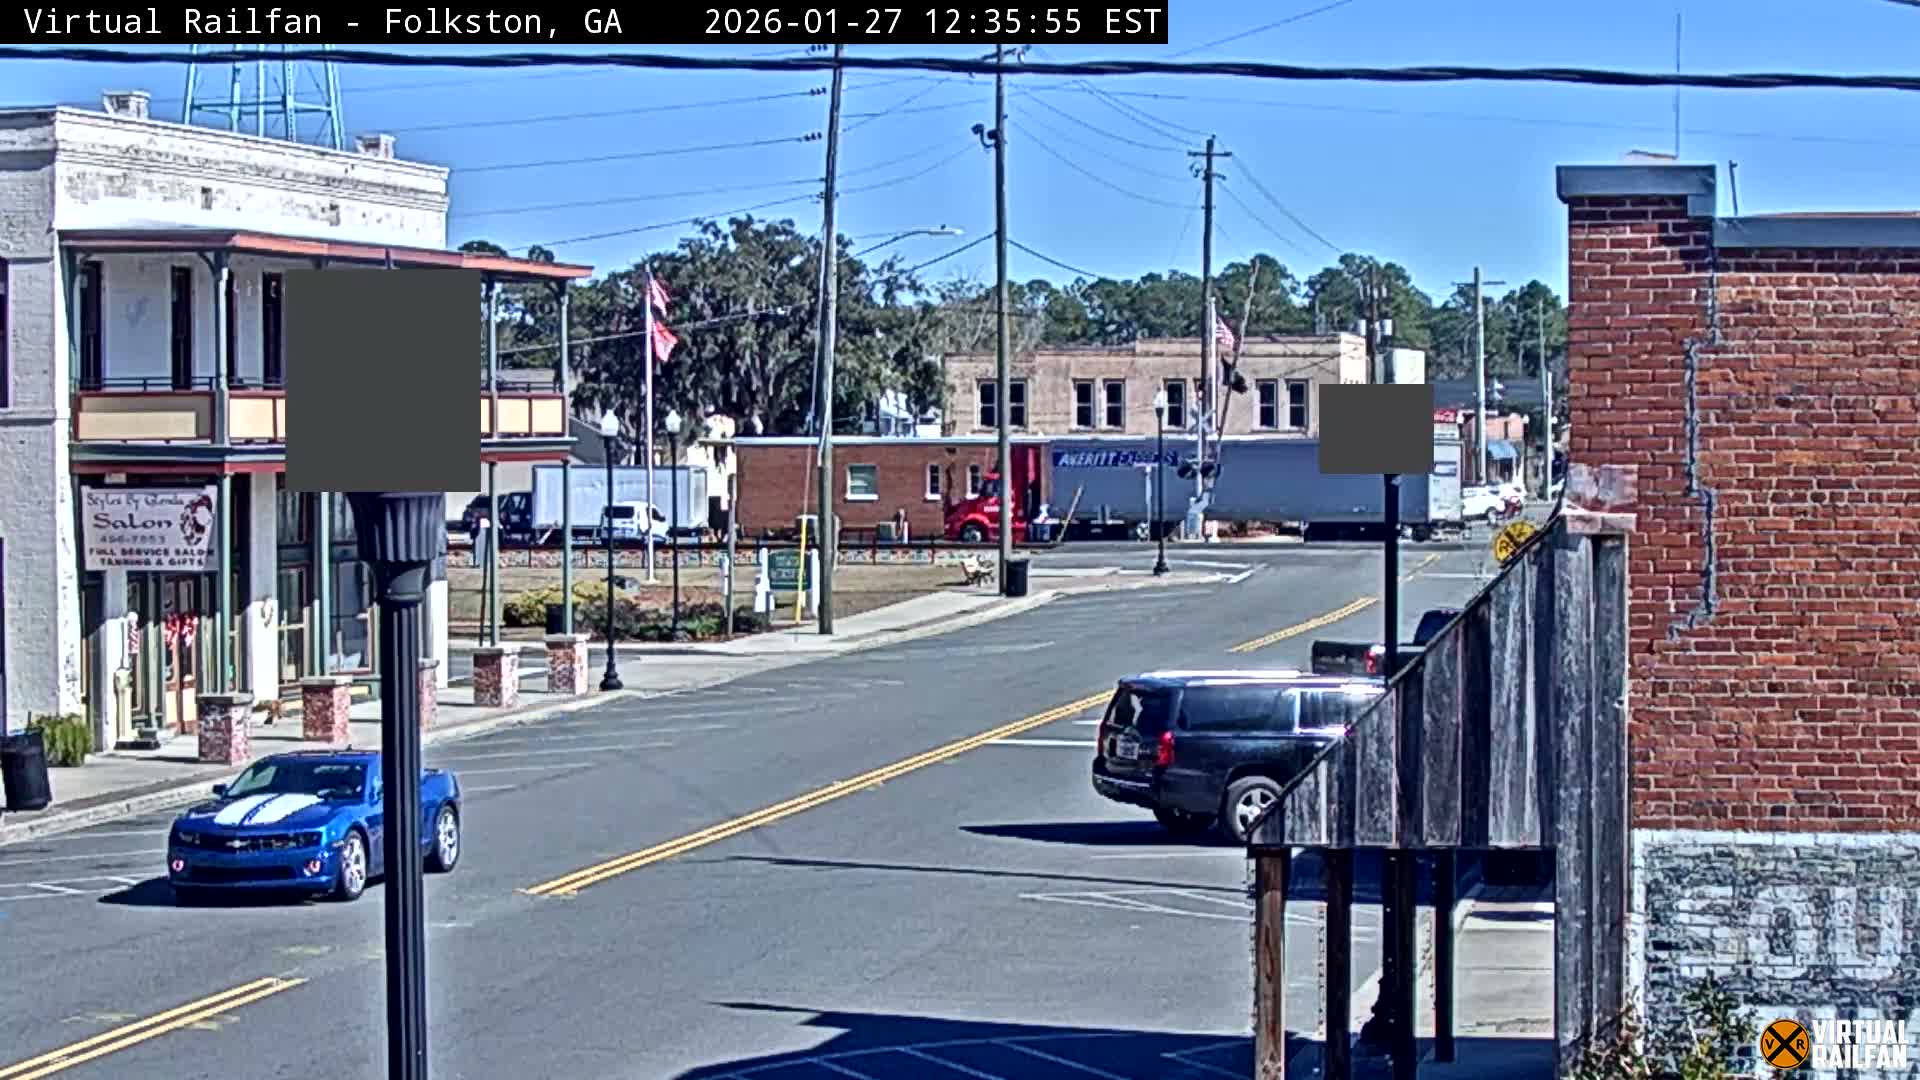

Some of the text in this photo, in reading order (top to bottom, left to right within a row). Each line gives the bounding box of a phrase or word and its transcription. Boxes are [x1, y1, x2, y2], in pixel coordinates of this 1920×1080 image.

[93, 512, 172, 529] Salon
[89, 547, 215, 556] FULL SERVICE SALON
[100, 558, 204, 566] TANNING & GIFTS
